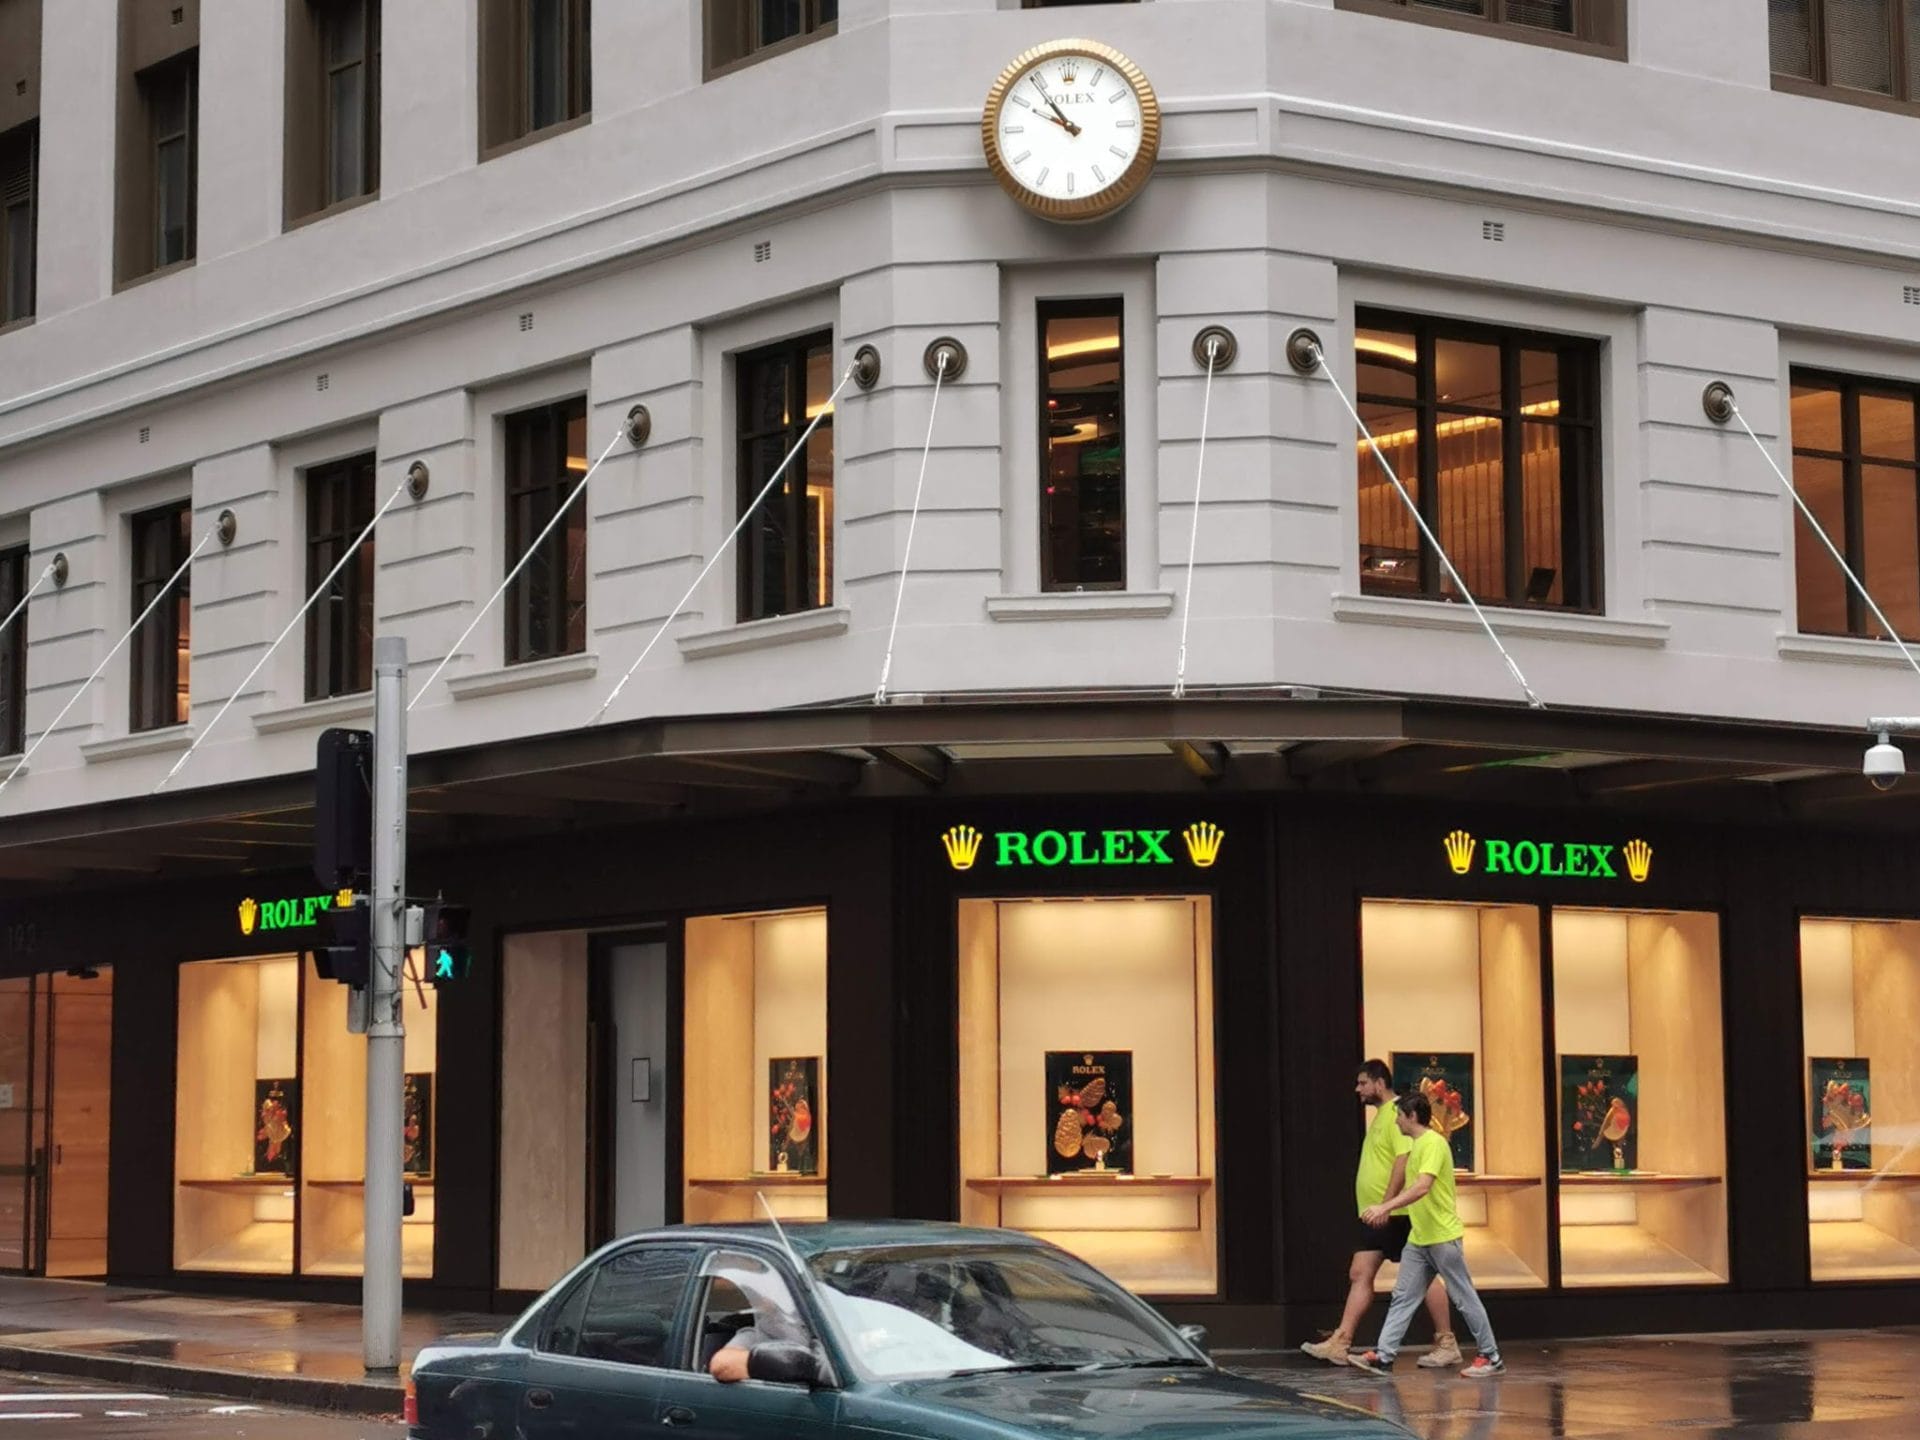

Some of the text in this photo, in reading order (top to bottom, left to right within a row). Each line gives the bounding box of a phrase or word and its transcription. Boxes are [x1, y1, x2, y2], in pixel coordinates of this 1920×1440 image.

[995, 829, 1173, 866] ROLEX
[1485, 839, 1617, 878] ROLEX
[1072, 1065, 1105, 1074] ROLEX
